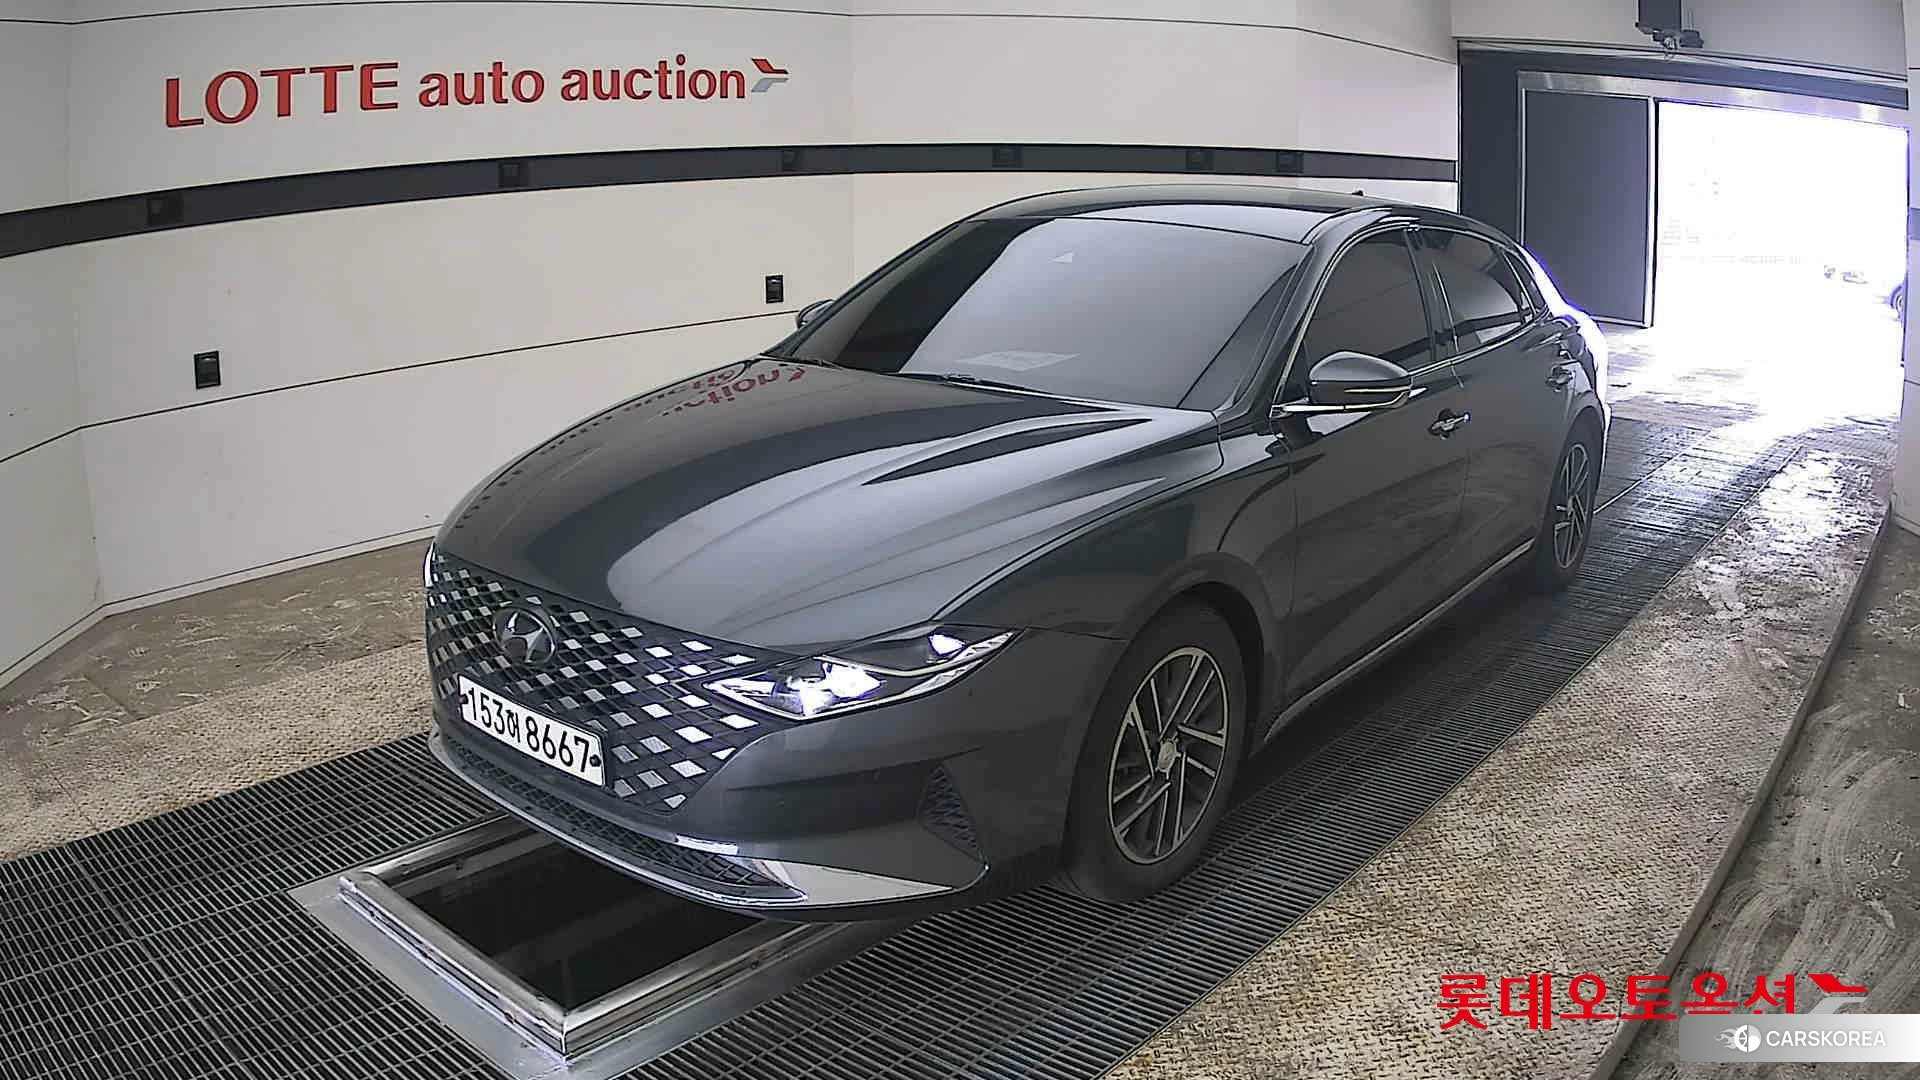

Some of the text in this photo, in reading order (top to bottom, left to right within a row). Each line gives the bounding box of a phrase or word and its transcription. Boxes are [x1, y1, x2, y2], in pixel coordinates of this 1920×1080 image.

[165, 54, 746, 128] LOTTE auto auction
[525, 715, 590, 773] 8667
